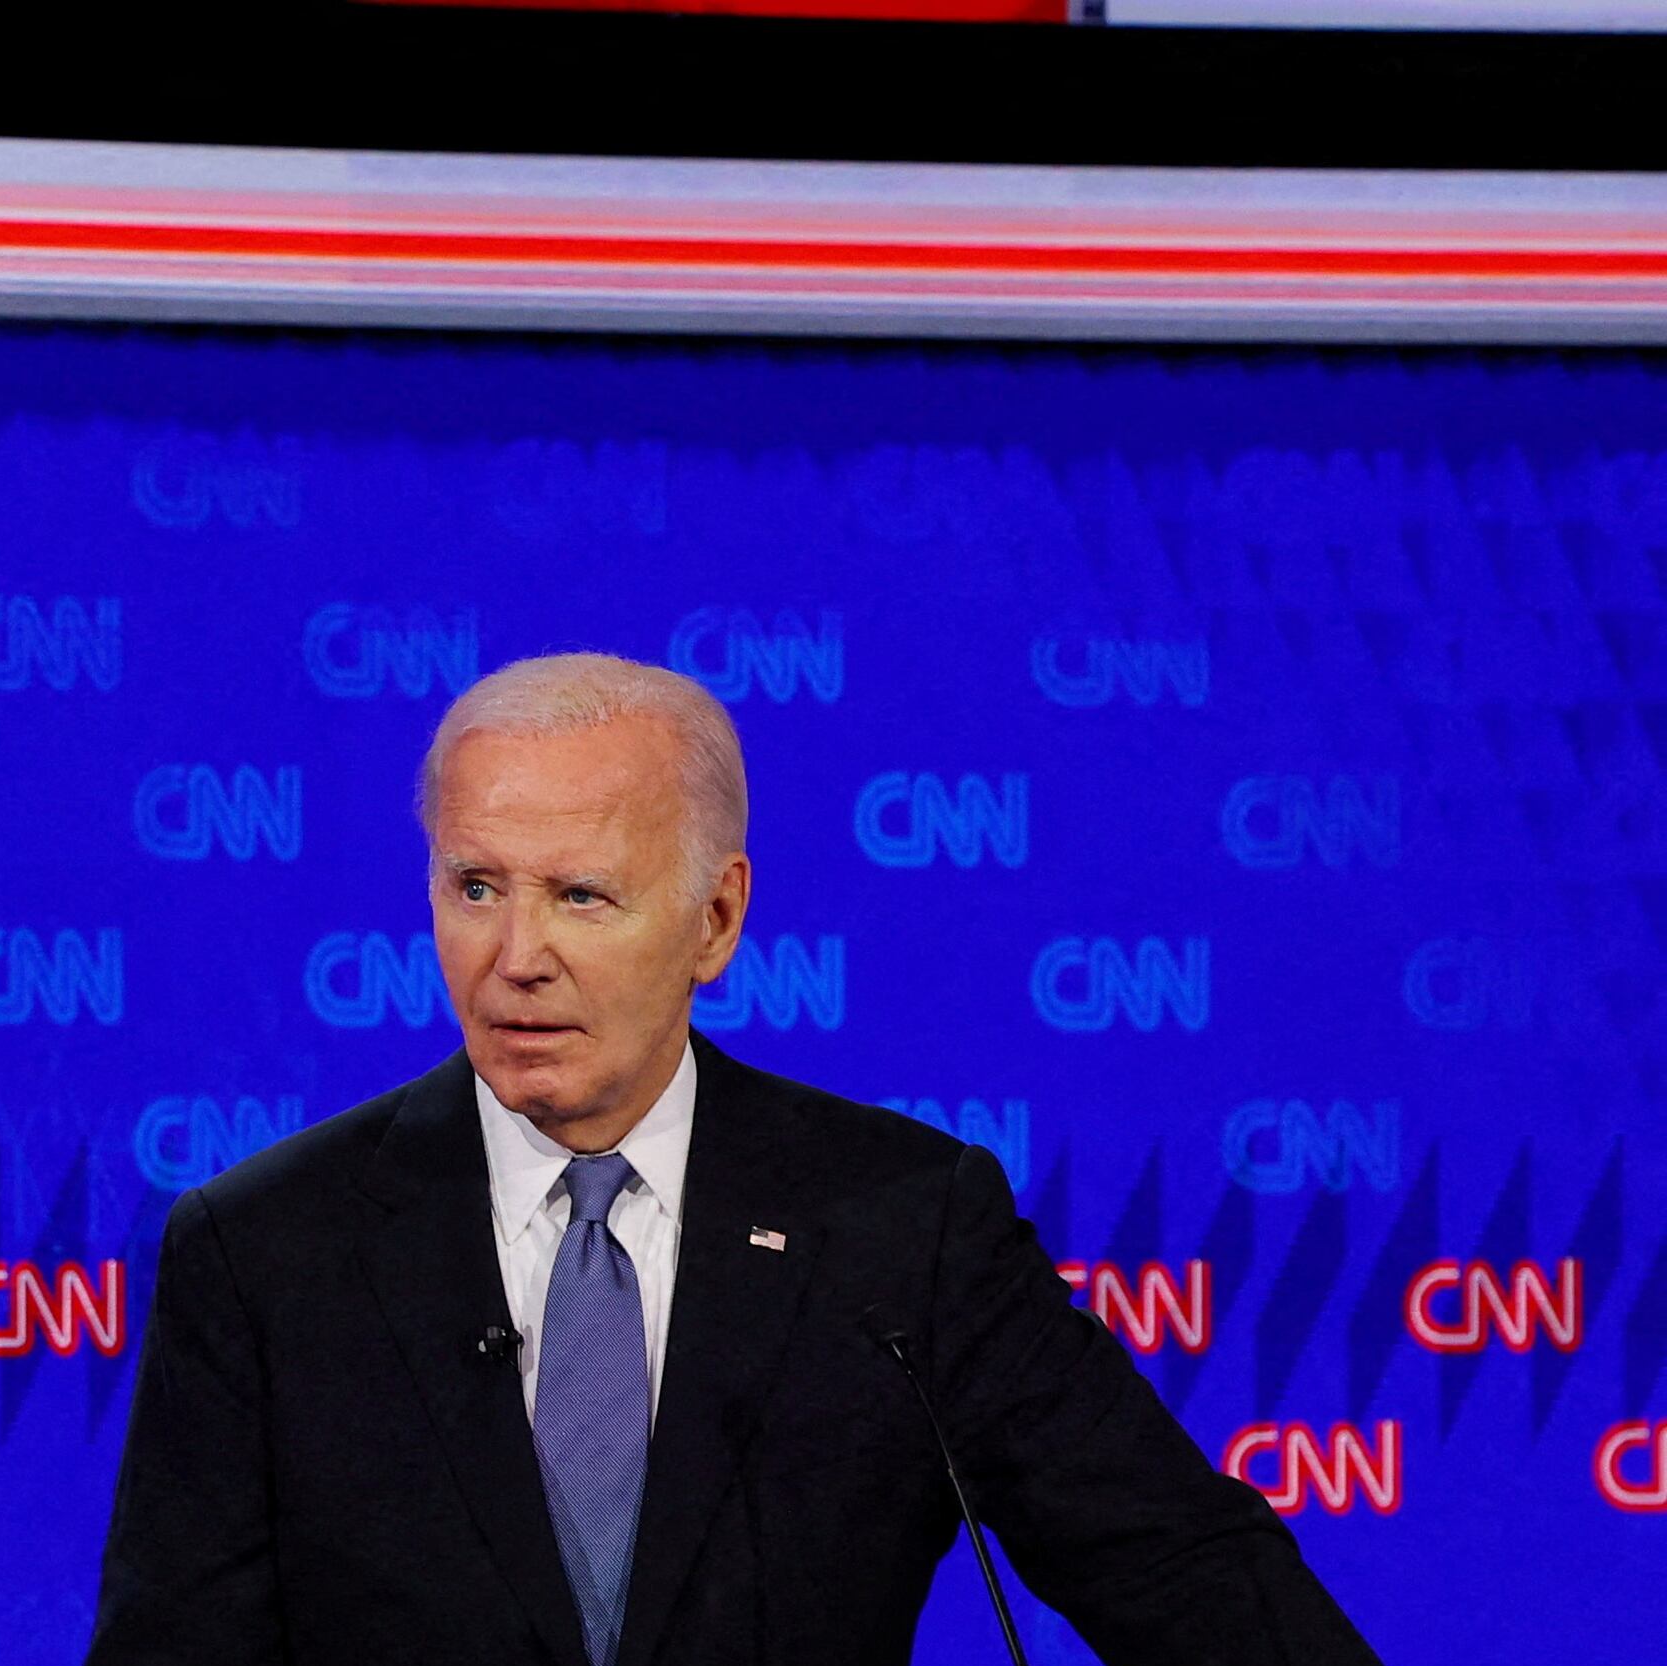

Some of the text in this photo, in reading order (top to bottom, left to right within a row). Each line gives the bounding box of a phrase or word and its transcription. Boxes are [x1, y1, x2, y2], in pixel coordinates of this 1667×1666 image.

[302, 602, 480, 701] CNN
[131, 762, 304, 863] CNN
[852, 770, 1032, 870] CNN
[1218, 772, 1403, 872] CNN
[1029, 933, 1213, 1034] CNN
[1219, 1096, 1404, 1196] CNN
[1055, 1257, 1211, 1355] NN
[1402, 1257, 1583, 1354] CNN
[1224, 1419, 1403, 1515] CNN
